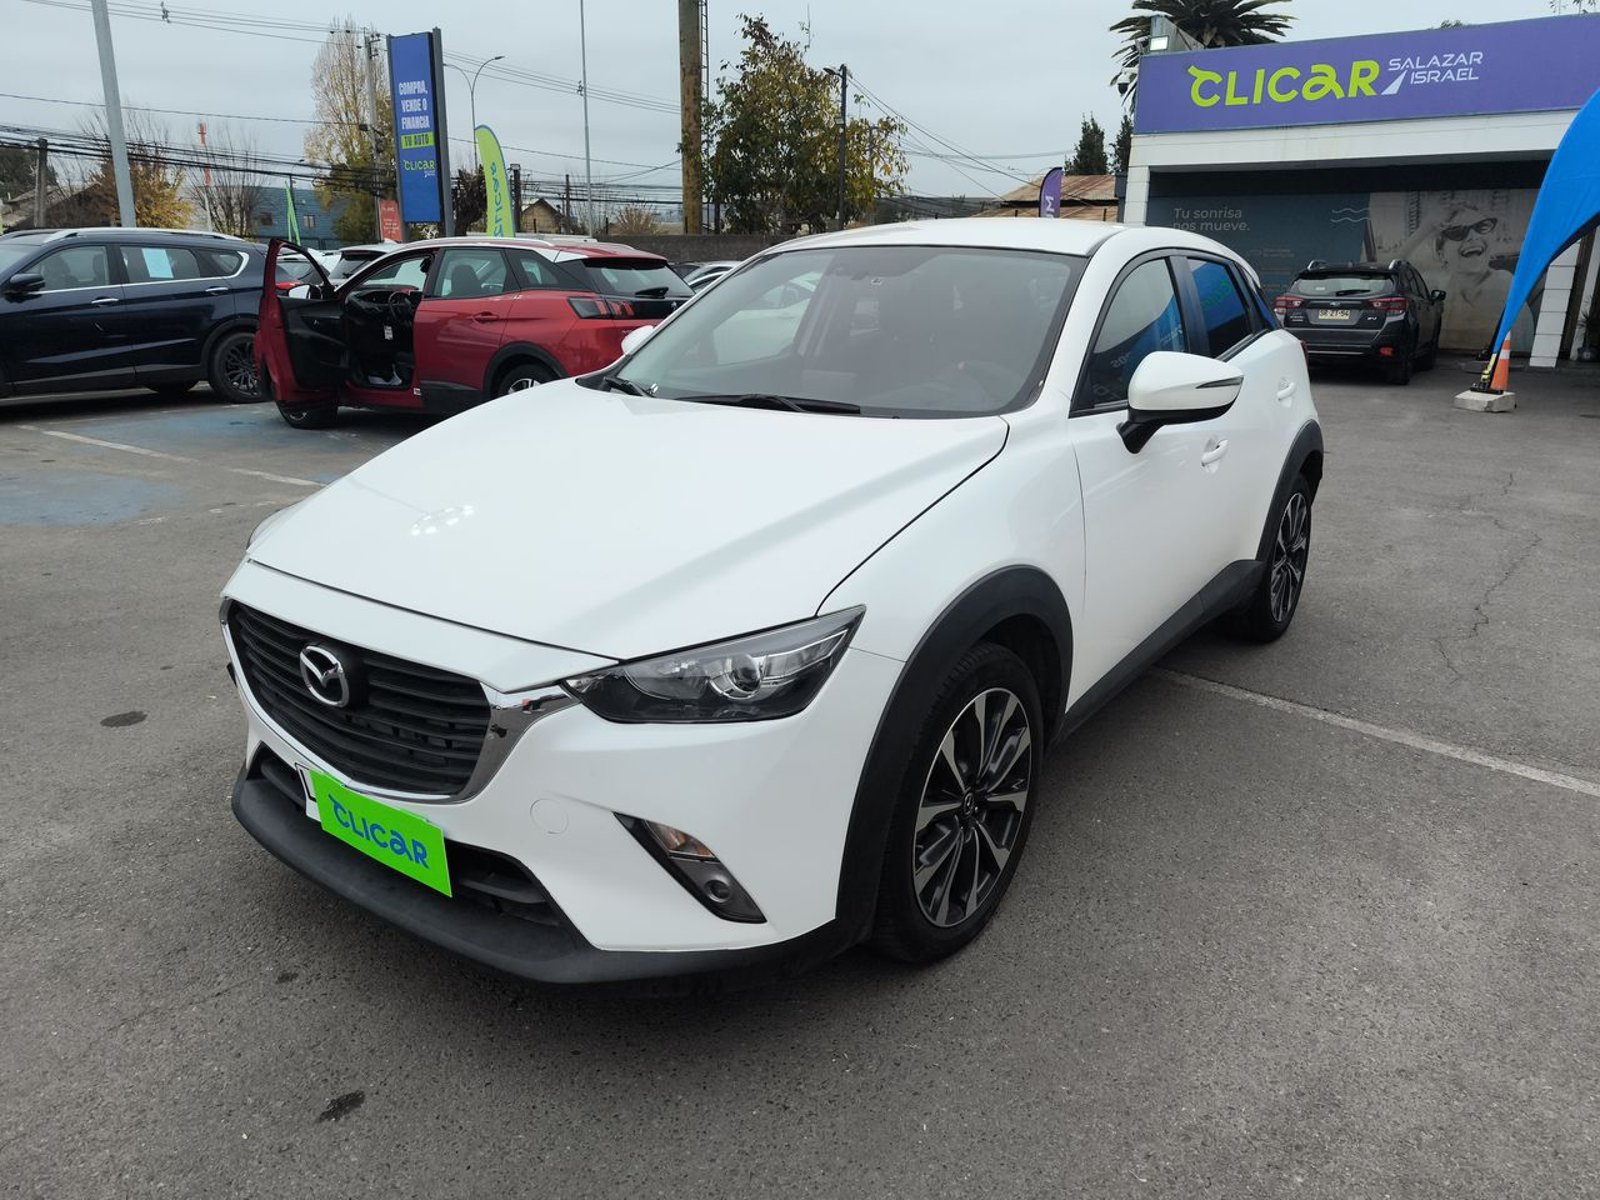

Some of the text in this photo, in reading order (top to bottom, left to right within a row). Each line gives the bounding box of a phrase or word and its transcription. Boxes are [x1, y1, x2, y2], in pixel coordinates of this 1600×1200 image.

[1388, 51, 1484, 71] SALAZAR
[1410, 68, 1480, 84] ISRAEL
[399, 80, 428, 95] COMPRA,
[401, 98, 427, 112] VENDE O
[401, 115, 430, 129] FINANCIA
[1174, 207, 1243, 219] Tu sonrisa
[1173, 221, 1250, 231] nos mueve.
